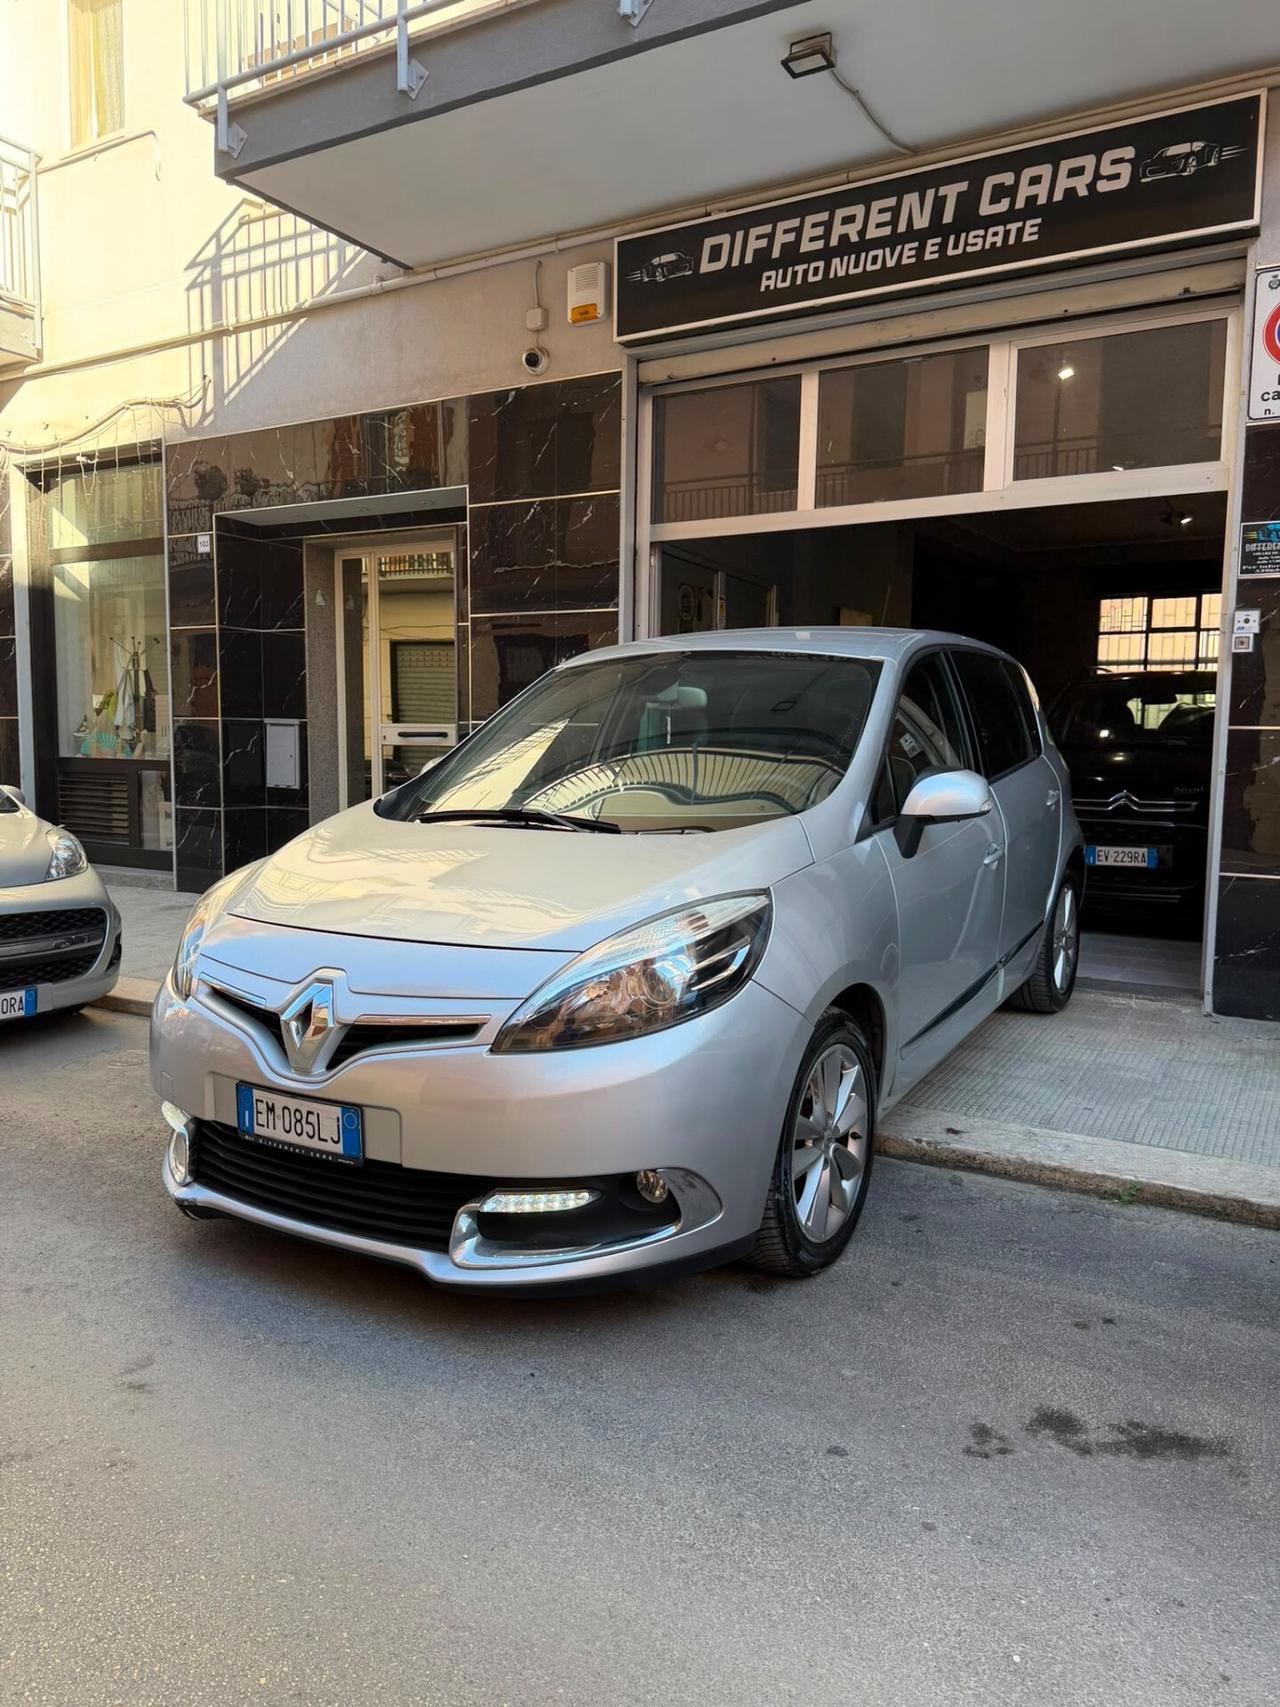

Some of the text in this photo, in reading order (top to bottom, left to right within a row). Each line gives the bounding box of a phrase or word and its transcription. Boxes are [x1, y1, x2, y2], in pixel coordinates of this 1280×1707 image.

[699, 145, 1136, 275] DIFFERENT CARS
[759, 217, 1043, 293] AUTO NUOVE E USATE
